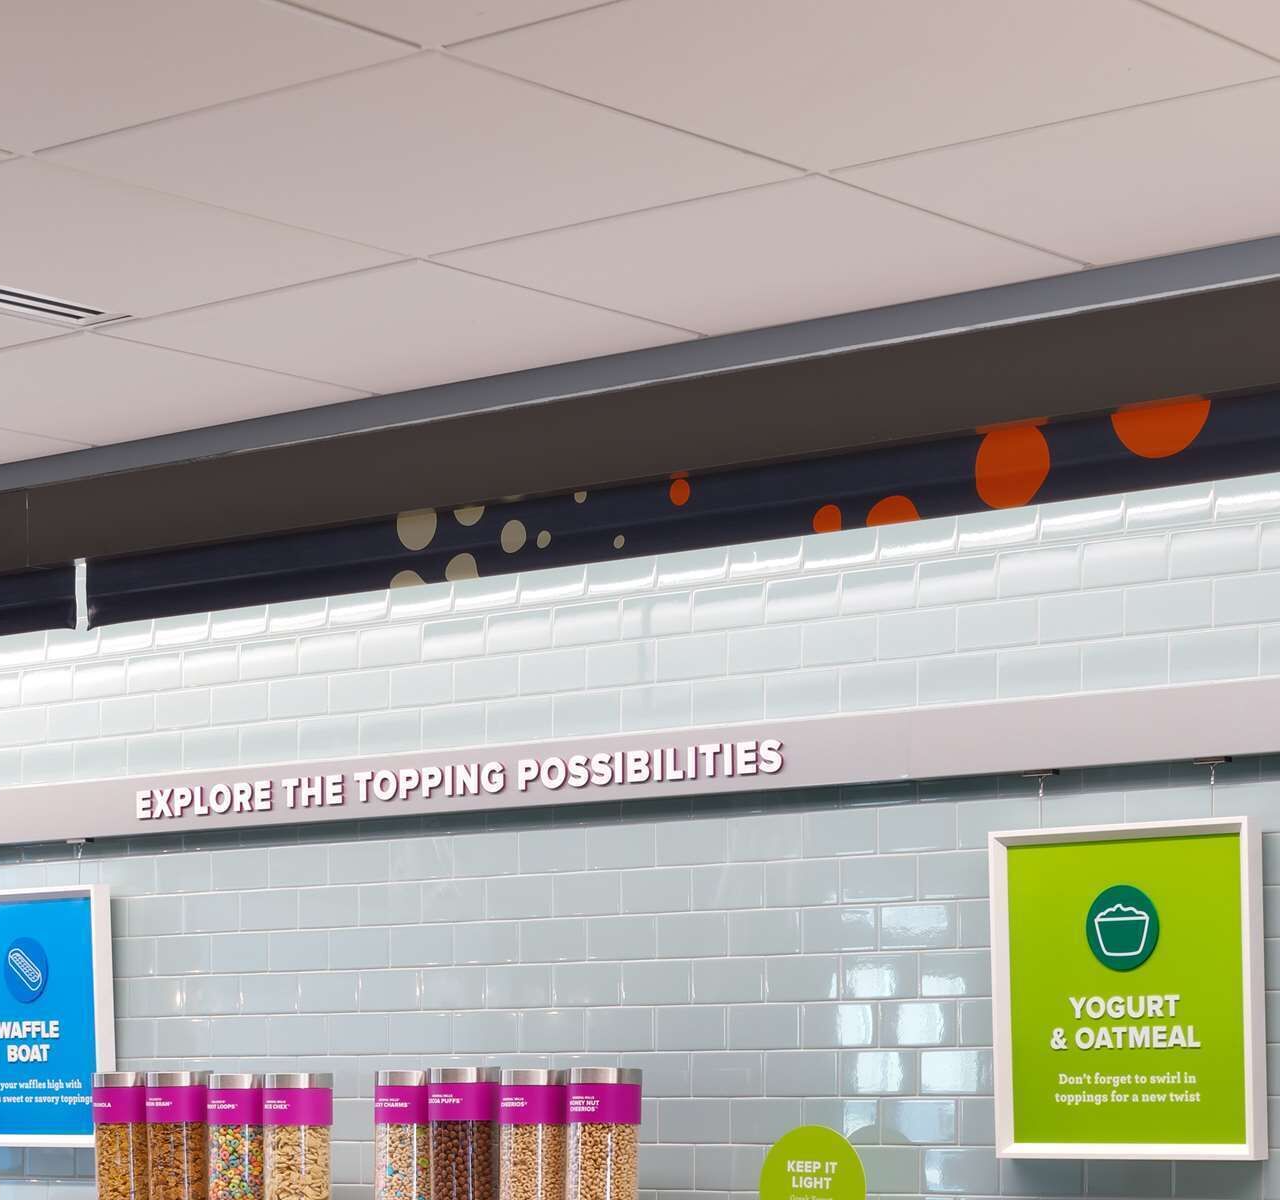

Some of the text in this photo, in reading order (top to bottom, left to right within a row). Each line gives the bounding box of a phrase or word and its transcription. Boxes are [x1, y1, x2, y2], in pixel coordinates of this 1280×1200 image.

[136, 739, 783, 819] EXPLORE THE TOPPING POSSIBILITIES
[1069, 994, 1180, 1019] YOGURT
[1050, 1025, 1201, 1050] & OATMEAL
[7, 1044, 50, 1063] BOAT
[0, 1082, 18, 1091] your
[19, 1079, 47, 1090] waffles
[47, 1079, 64, 1091] high
[65, 1079, 83, 1090] with
[1058, 1072, 1197, 1087] Don't forget to swirl in
[2, 1094, 24, 1104] sweet
[25, 1095, 33, 1103] or
[35, 1095, 59, 1106] savory
[60, 1093, 93, 1105] toppings
[1055, 1090, 1201, 1105] toppings for a new twist
[786, 1160, 838, 1174] KEEP IT
[791, 1176, 832, 1189] LIGHT
